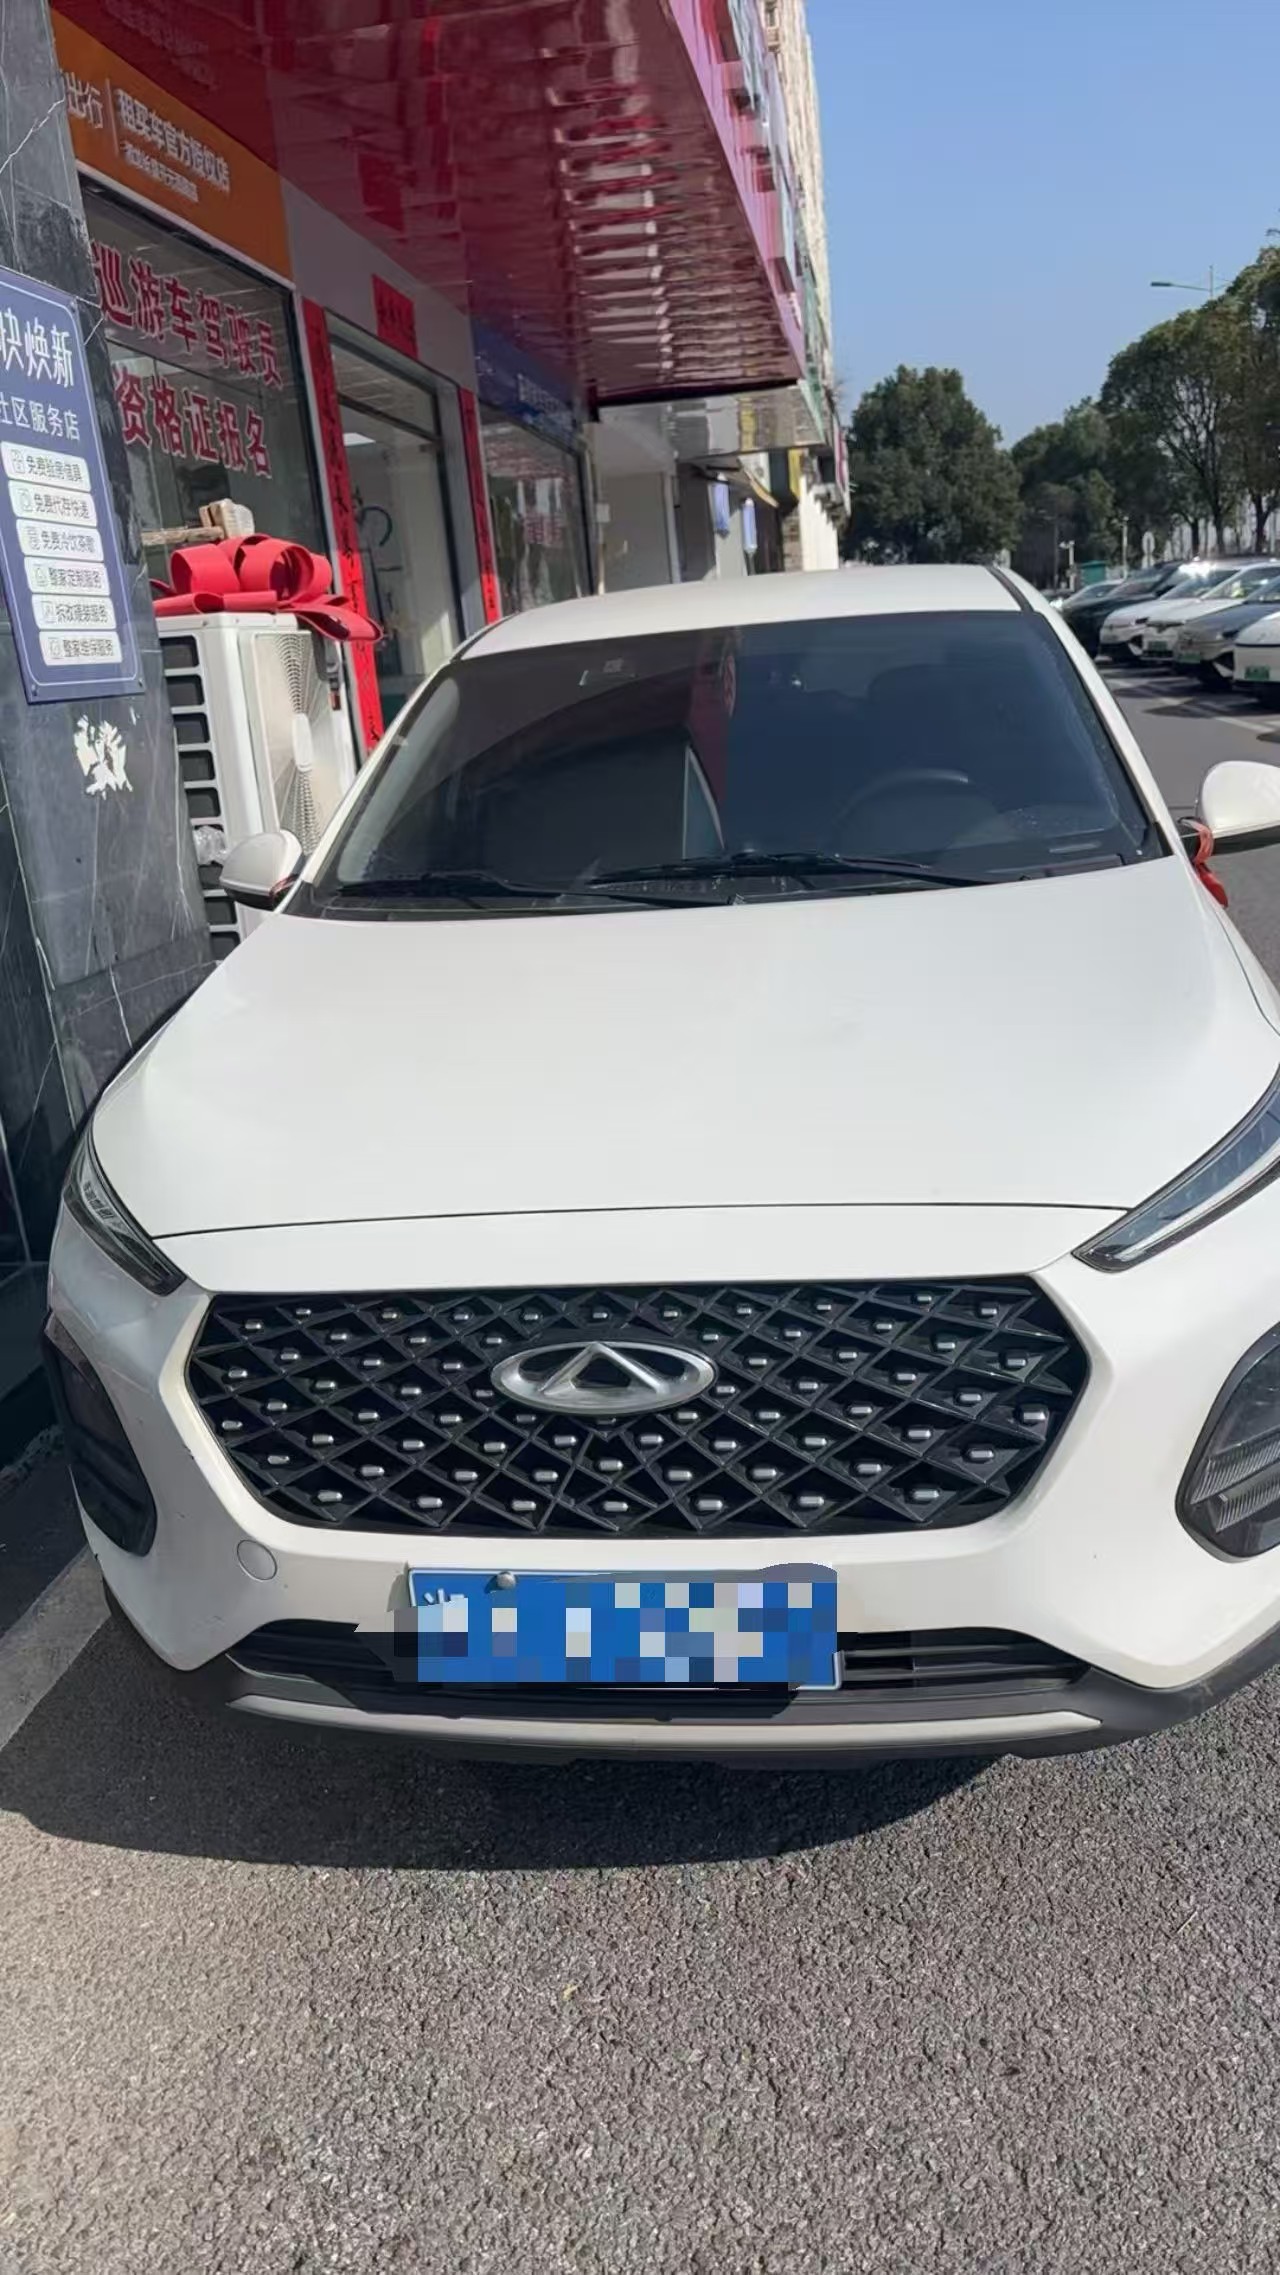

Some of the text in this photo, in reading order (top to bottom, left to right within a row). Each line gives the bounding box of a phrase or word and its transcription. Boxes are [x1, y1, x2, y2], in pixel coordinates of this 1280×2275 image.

[65, 72, 103, 128] 出行
[89, 240, 283, 390] 巡游车驾驶员
[113, 364, 272, 478] 资格证报名
